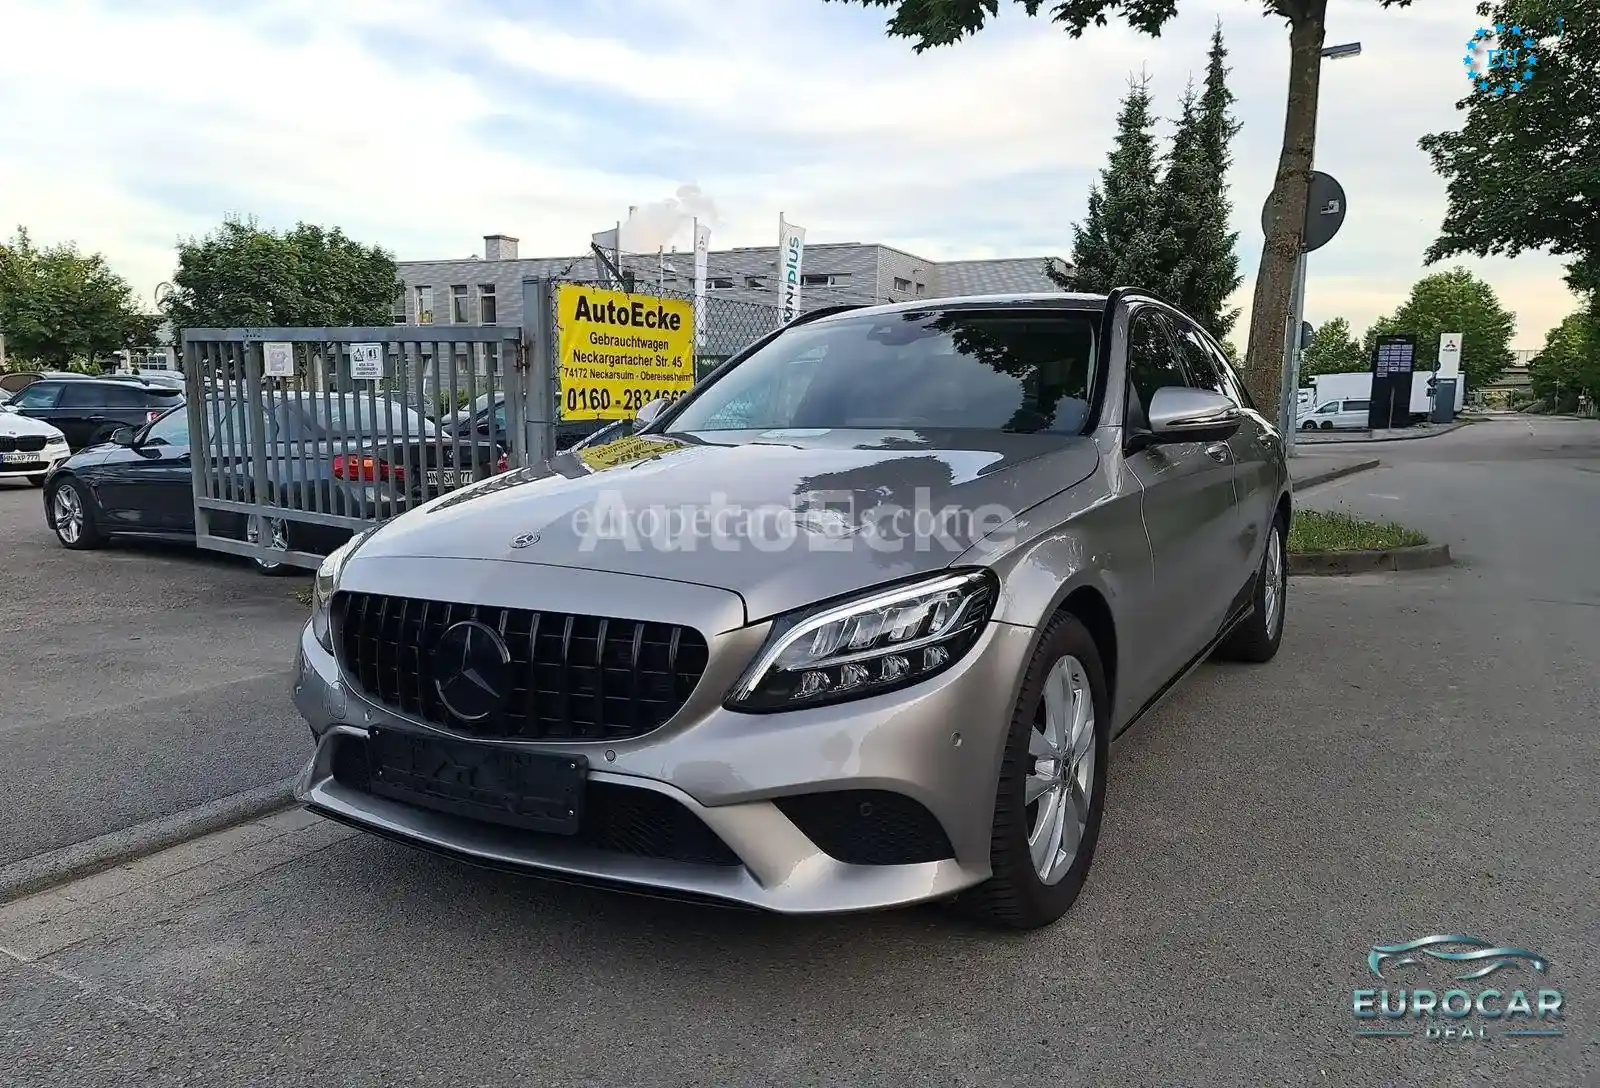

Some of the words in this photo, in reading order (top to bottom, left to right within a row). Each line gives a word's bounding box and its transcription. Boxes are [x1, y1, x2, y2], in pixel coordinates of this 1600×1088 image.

[575, 296, 680, 331] AutoEcke
[590, 332, 669, 352] Gebrauchtwagen
[573, 349, 653, 367] Neckargartacher
[656, 355, 670, 367] Str.
[672, 357, 683, 368] 45
[564, 368, 588, 378] 74172
[590, 369, 634, 380] Neckarsulm
[567, 387, 611, 411] 0160
